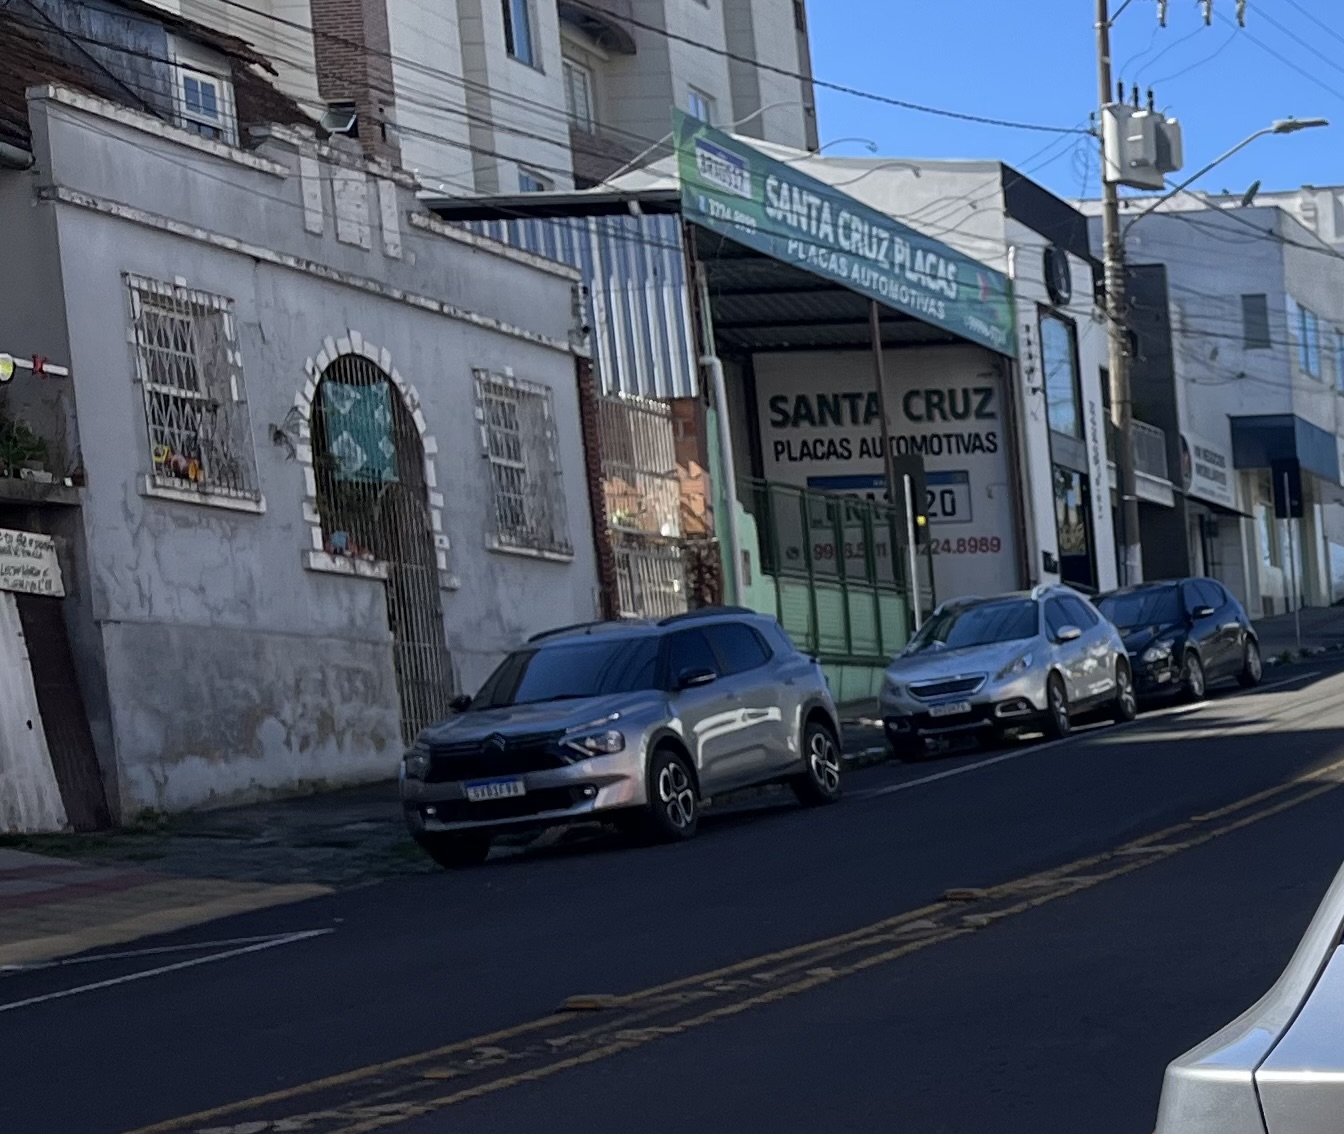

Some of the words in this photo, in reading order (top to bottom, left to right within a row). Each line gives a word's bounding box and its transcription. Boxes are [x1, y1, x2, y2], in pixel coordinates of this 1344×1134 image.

[765, 175, 834, 243] SANTA
[838, 209, 889, 270] CRUZ
[894, 236, 958, 300] PLACAS
[788, 239, 848, 277] PLACAS
[851, 263, 946, 320] AUTOMOTIVAS
[769, 391, 887, 428] SANTA
[903, 387, 998, 423] CRUZ
[774, 438, 852, 462] PLACAS
[859, 431, 998, 459] AUTOMOTIVAS
